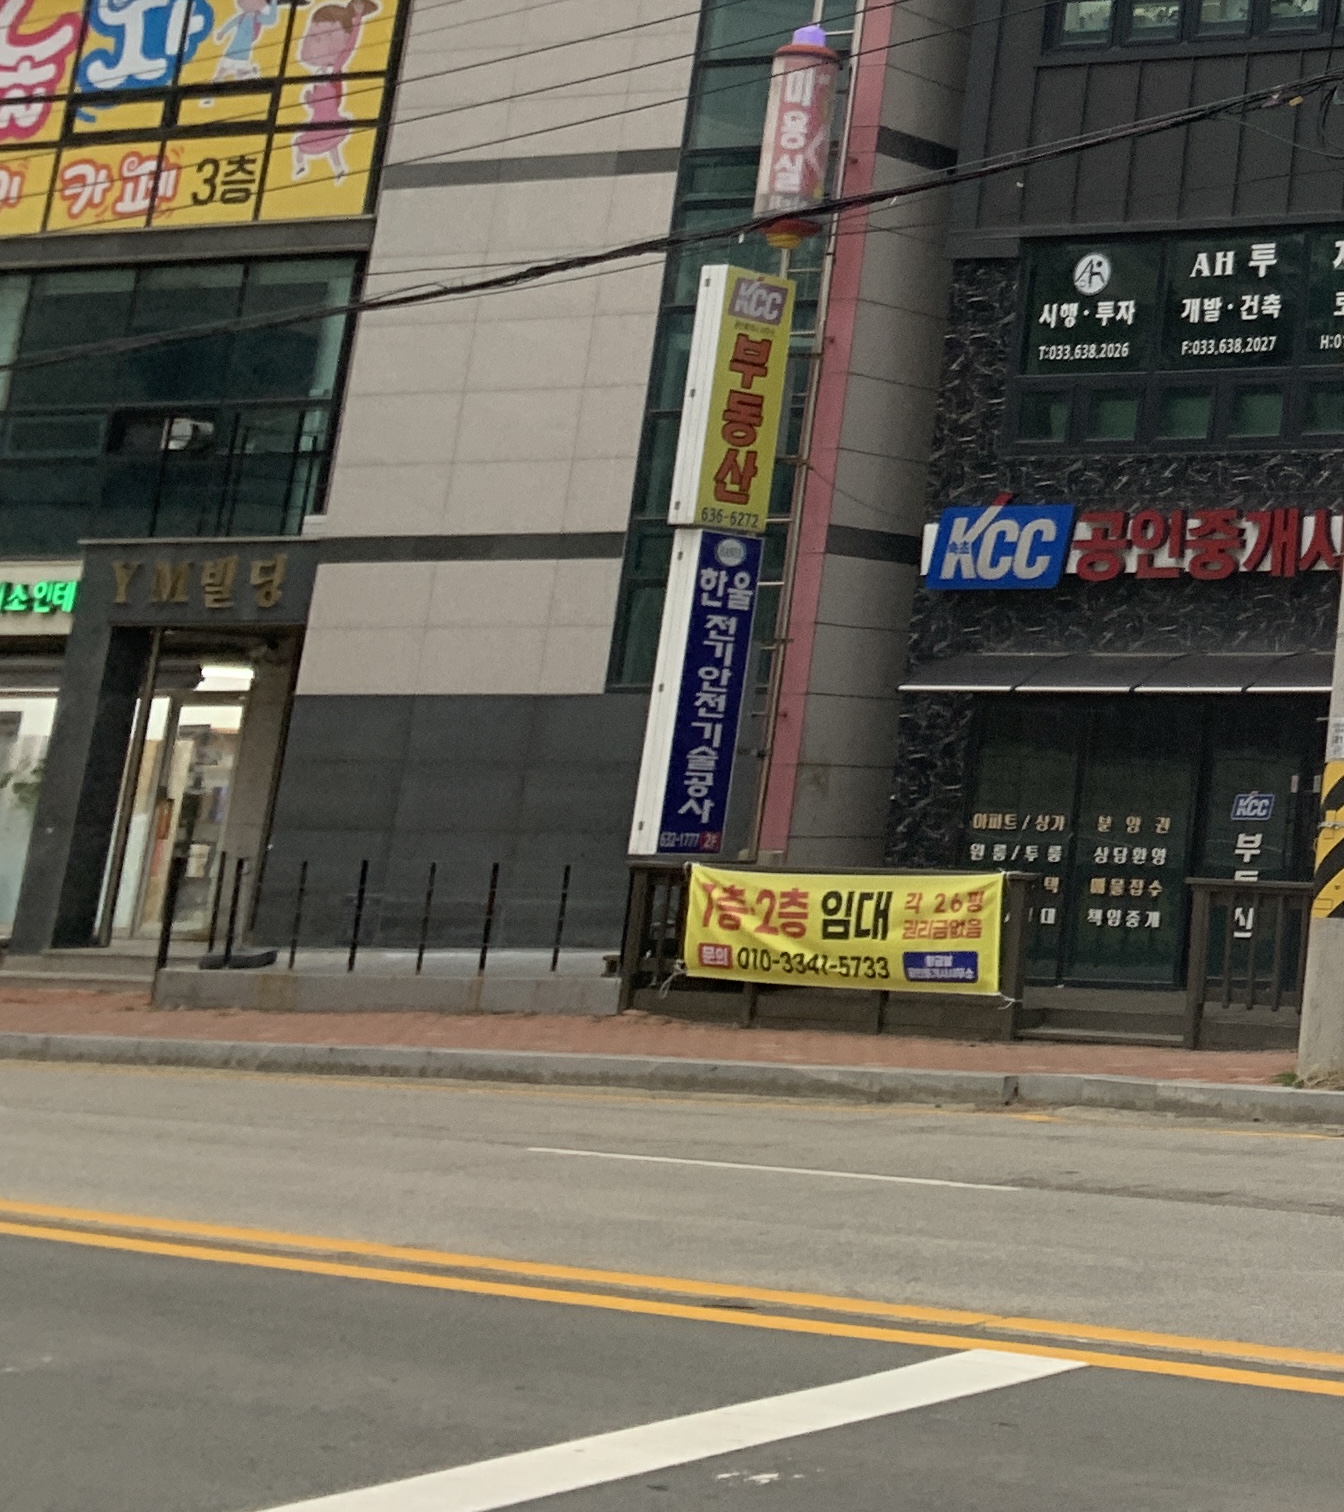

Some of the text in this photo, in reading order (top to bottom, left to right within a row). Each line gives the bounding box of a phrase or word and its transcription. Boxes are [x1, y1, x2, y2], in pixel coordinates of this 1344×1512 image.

[62, 155, 178, 216] 카페
[191, 155, 257, 206] 3층
[1188, 250, 1236, 278] AH
[734, 279, 783, 321] KCC
[713, 333, 773, 505] 부동산
[701, 506, 760, 529] 636-6272
[940, 491, 1058, 581] KCC
[0, 580, 78, 614] 소인테
[700, 567, 754, 612] 한울
[1236, 791, 1270, 816] KCC
[821, 890, 894, 941] 임대
[902, 918, 982, 940] 권리금없음
[701, 945, 728, 966] 문의
